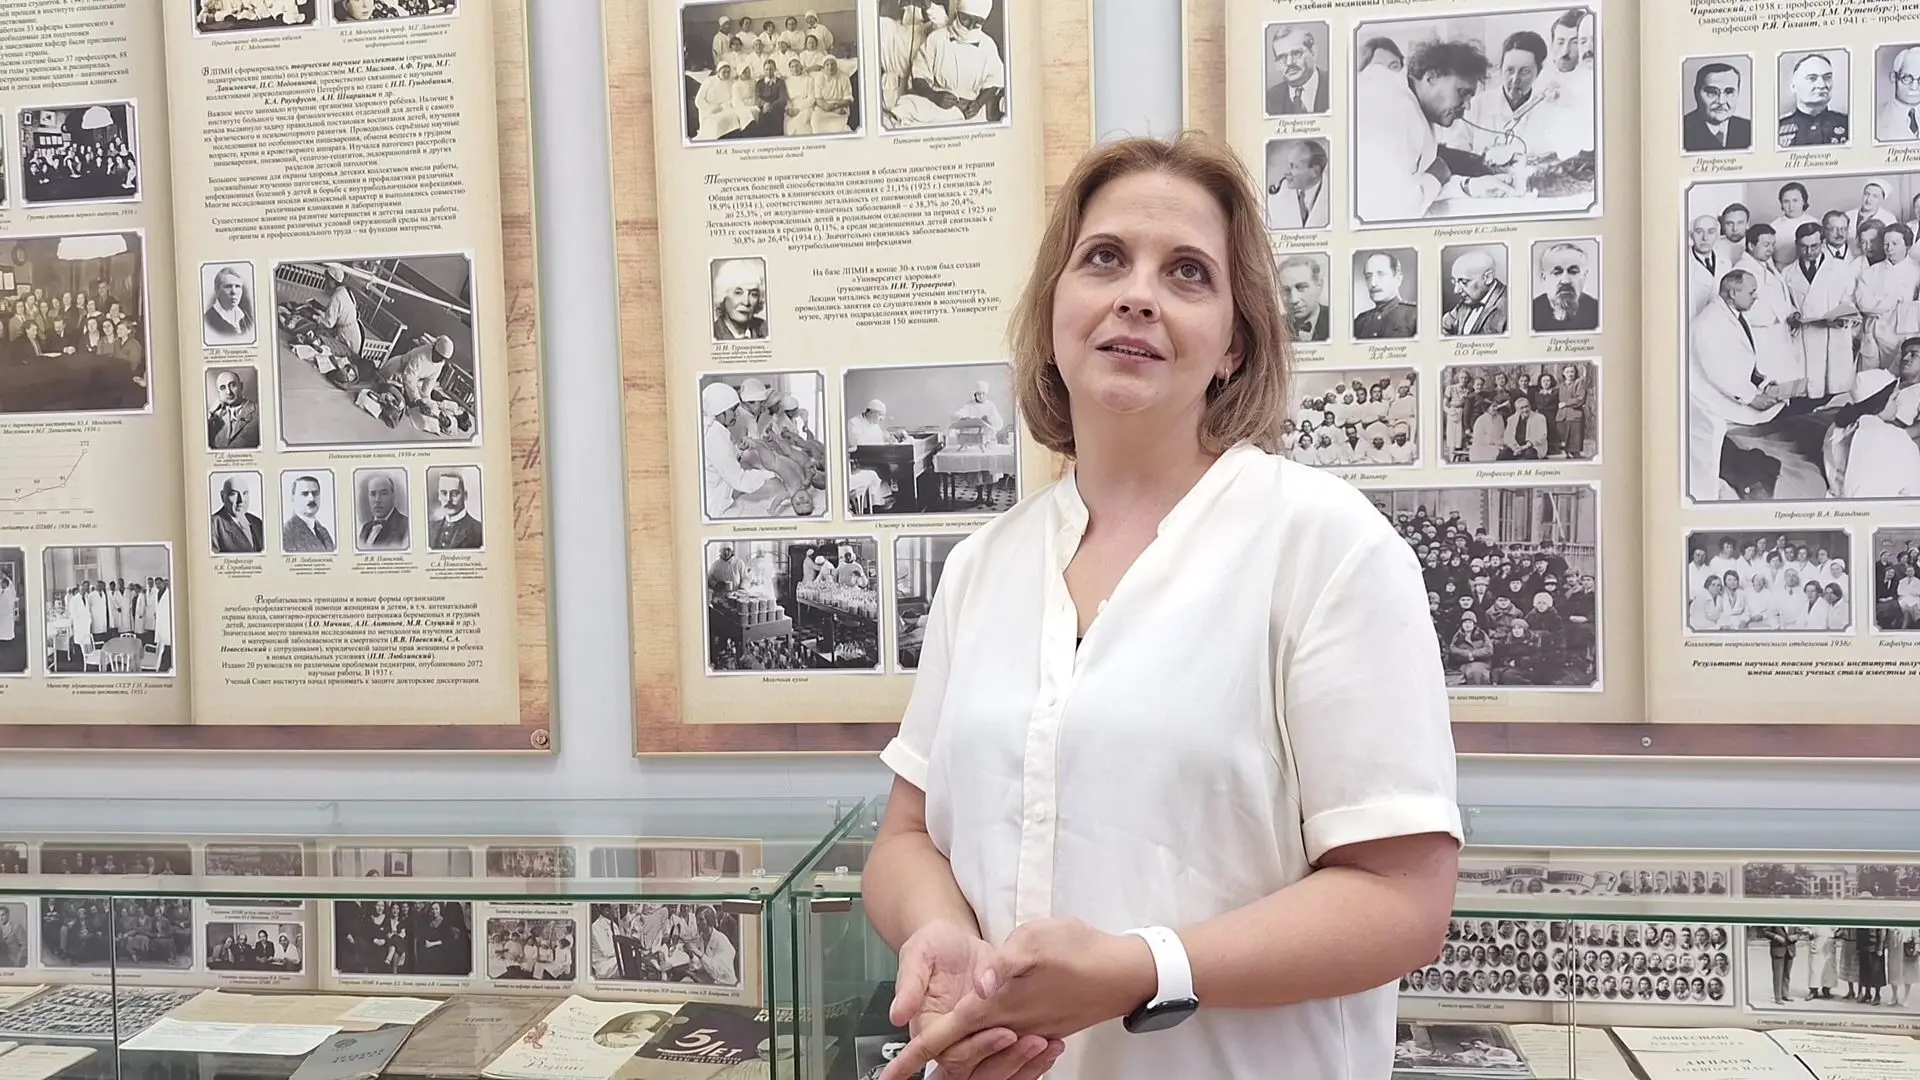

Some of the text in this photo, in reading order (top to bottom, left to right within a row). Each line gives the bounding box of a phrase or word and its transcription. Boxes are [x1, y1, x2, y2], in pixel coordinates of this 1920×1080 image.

[1786, 0, 1835, 12] профессор
[1698, 12, 1757, 26] (заведующий
[1767, 10, 1816, 22] профессор
[1712, 23, 1759, 35] профессор
[824, 268, 840, 276] базе
[842, 266, 868, 275] ЛПМИ
[876, 266, 897, 274] конце
[916, 264, 937, 272] годов
[939, 262, 954, 270] был
[955, 262, 981, 270] создан
[852, 273, 941, 284] «Университет здоровья»
[836, 284, 888, 293] (руководитель
[911, 279, 955, 290] Туроверова)
[808, 295, 836, 303] Лекции
[872, 292, 910, 301] ведущими
[912, 291, 945, 299] учеными
[794, 304, 842, 313] проводились
[882, 300, 931, 309] слушателями
[939, 296, 976, 305] молочной
[823, 312, 848, 320] других
[850, 309, 908, 318] подразделениях
[951, 305, 998, 313] Университет
[856, 319, 891, 327] окончили
[675, 1028, 719, 1049] 5
